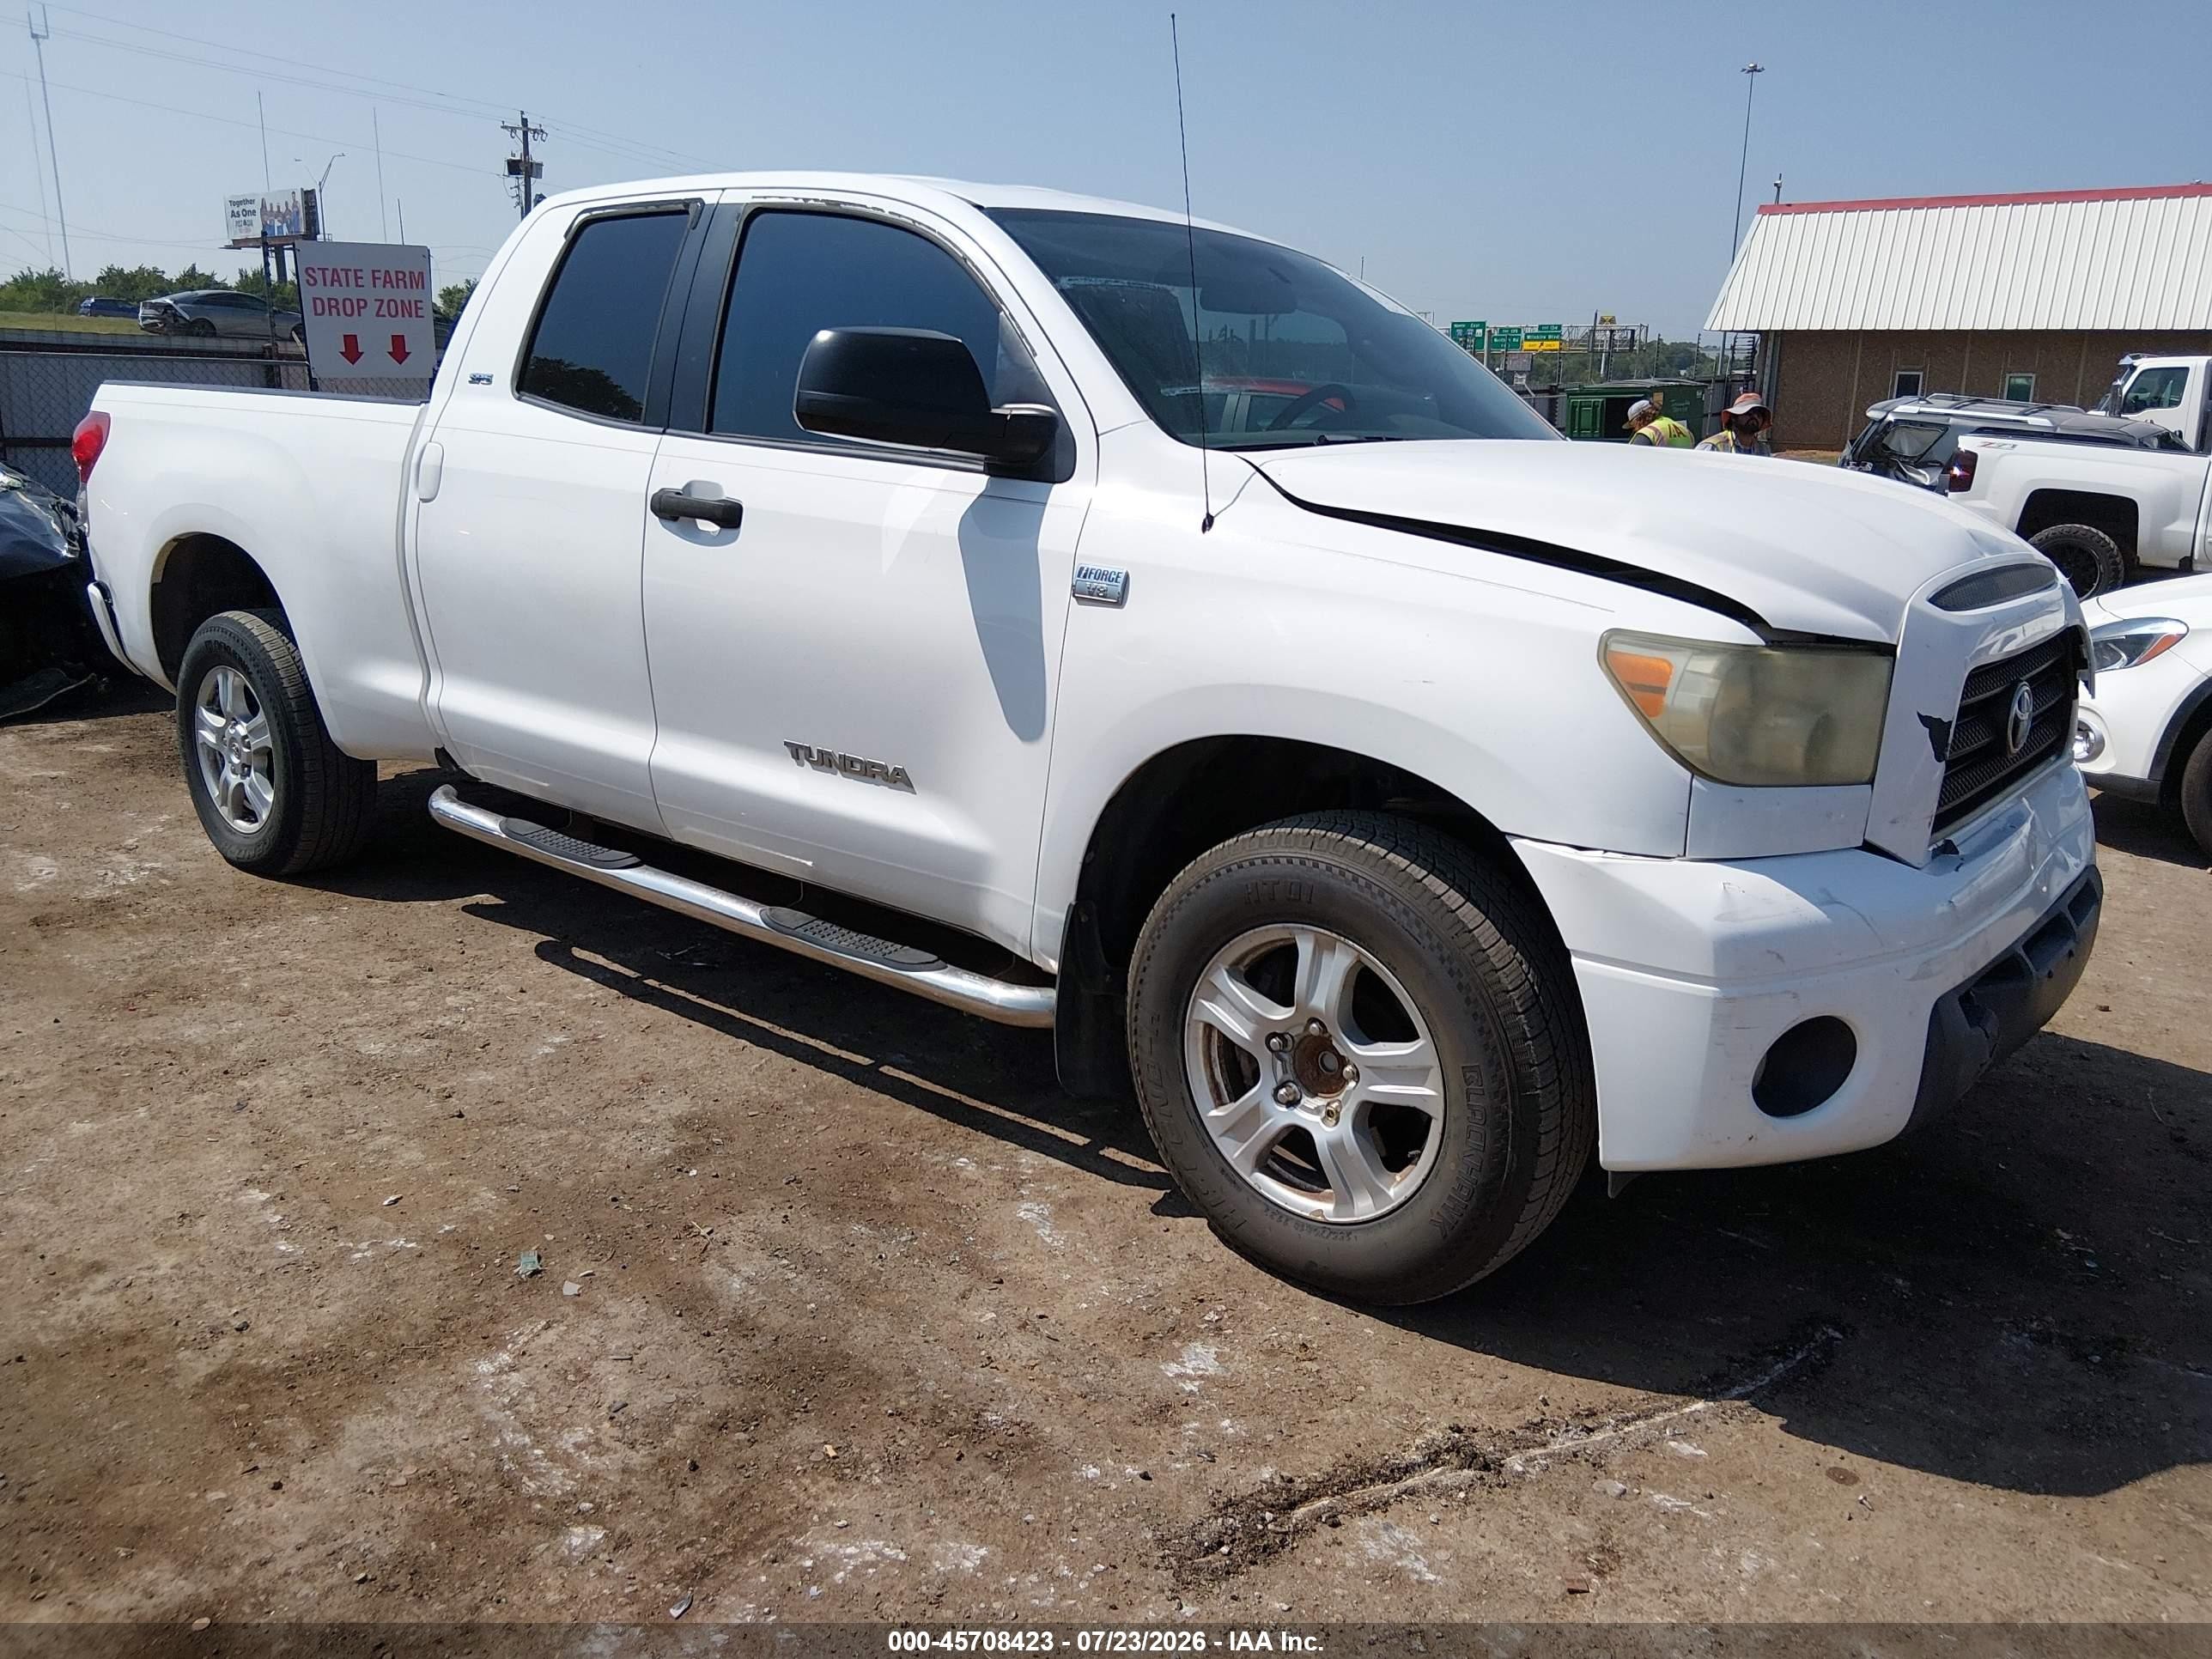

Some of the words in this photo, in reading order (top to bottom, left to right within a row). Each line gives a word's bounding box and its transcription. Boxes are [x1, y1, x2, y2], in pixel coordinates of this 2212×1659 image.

[228, 198, 256, 207] Together
[231, 210, 240, 218] As
[241, 208, 257, 216] One
[304, 266, 365, 288] STATE
[371, 269, 425, 289] FARM
[312, 297, 368, 317] DROP
[374, 298, 425, 319] ZONE
[783, 738, 917, 795] TUNDRA
